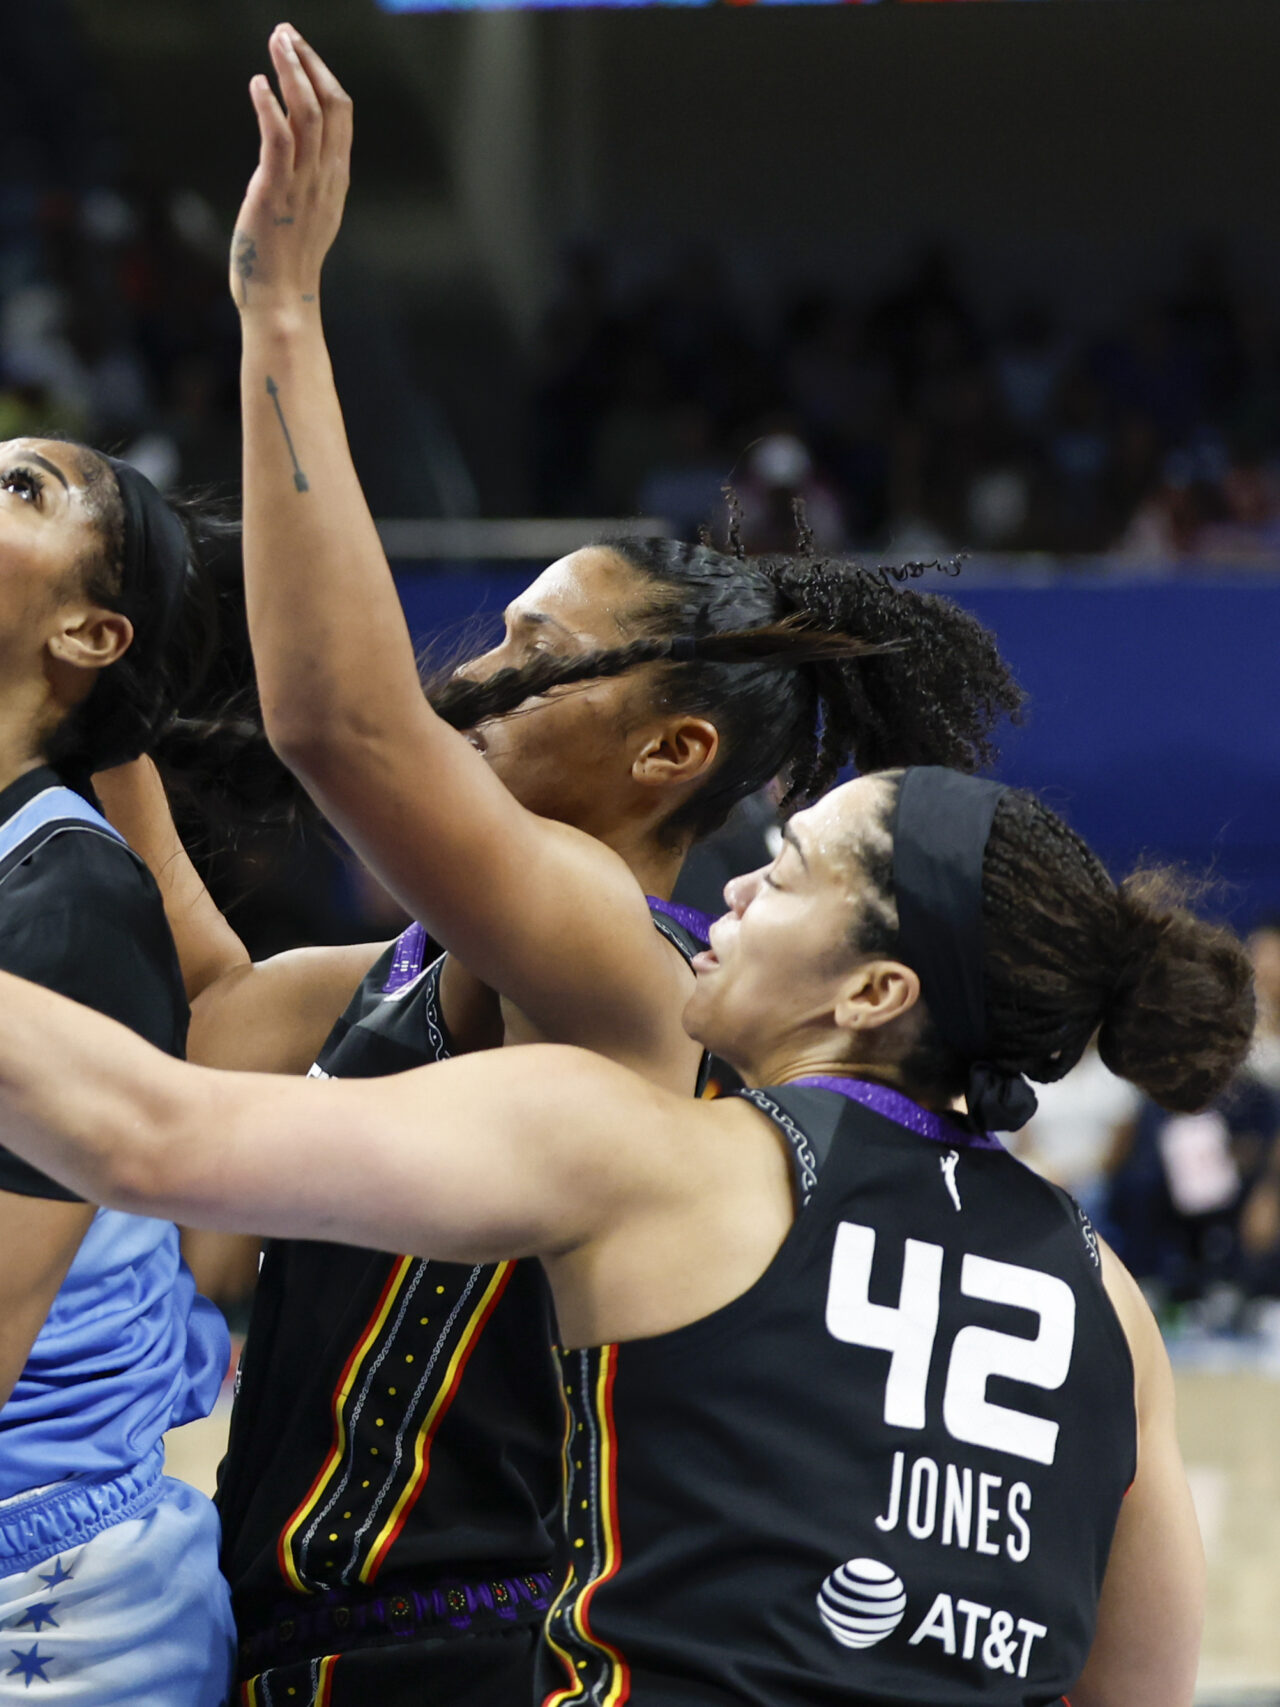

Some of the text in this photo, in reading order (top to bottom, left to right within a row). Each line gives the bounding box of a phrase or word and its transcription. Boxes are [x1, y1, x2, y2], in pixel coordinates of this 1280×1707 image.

[826, 1221, 1076, 1466] 42
[875, 1451, 1032, 1563] JONES
[908, 1592, 1048, 1678] AT&T
